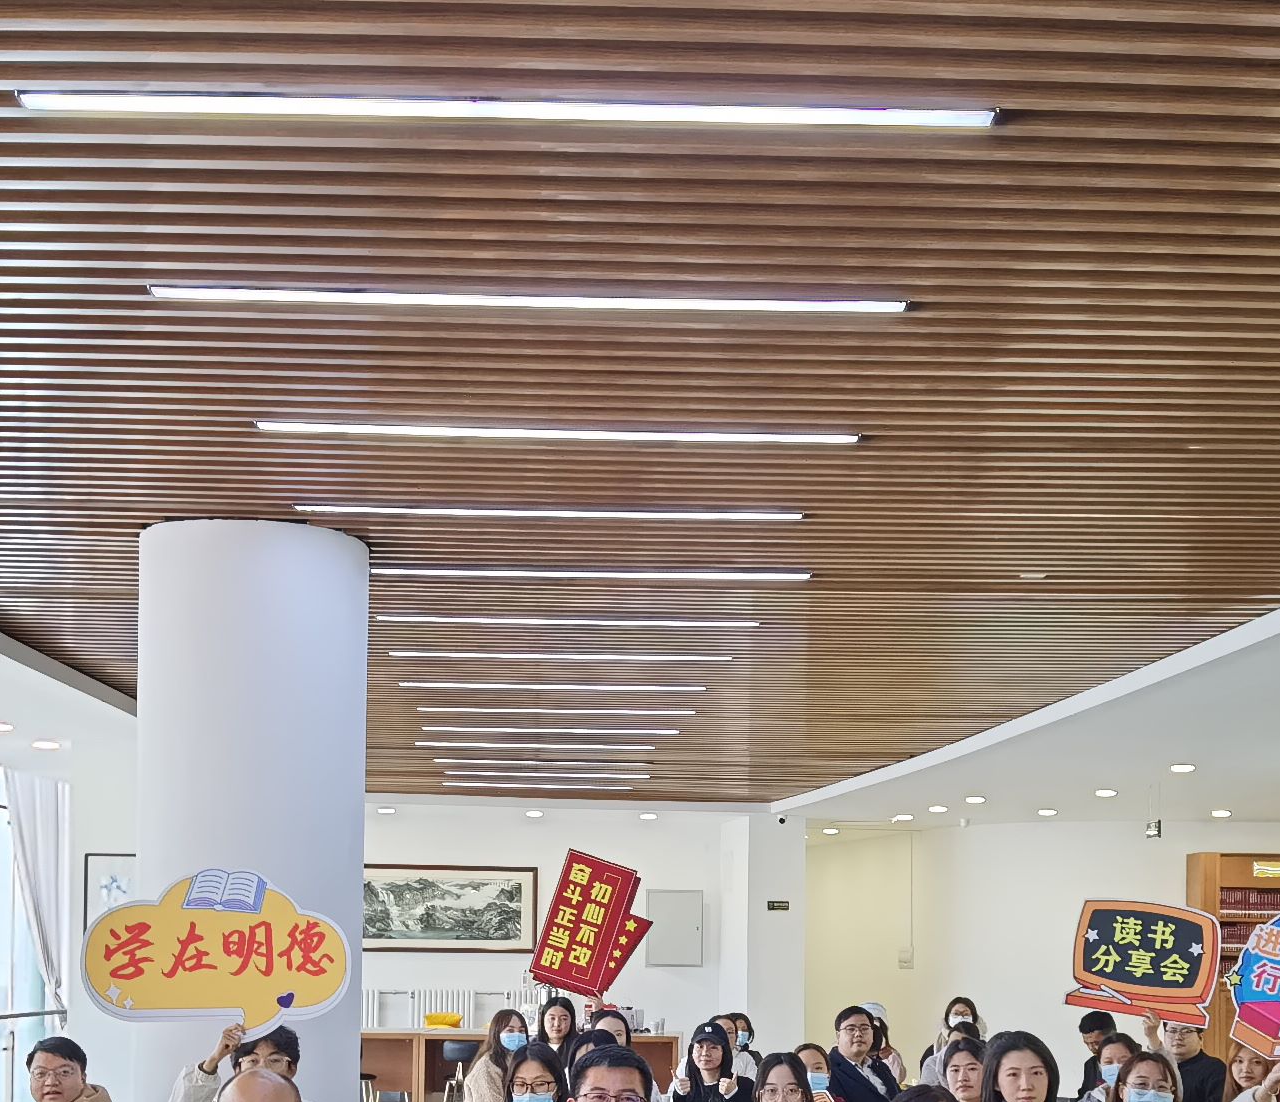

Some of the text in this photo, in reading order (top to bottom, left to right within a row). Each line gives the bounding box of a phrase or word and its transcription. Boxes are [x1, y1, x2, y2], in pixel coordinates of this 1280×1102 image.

[540, 862, 593, 970] 奋斗正当时
[568, 881, 613, 968] 初心不改
[1113, 915, 1177, 951] 读书
[103, 920, 335, 981] 学在明德
[1091, 944, 1191, 985] 分享会
